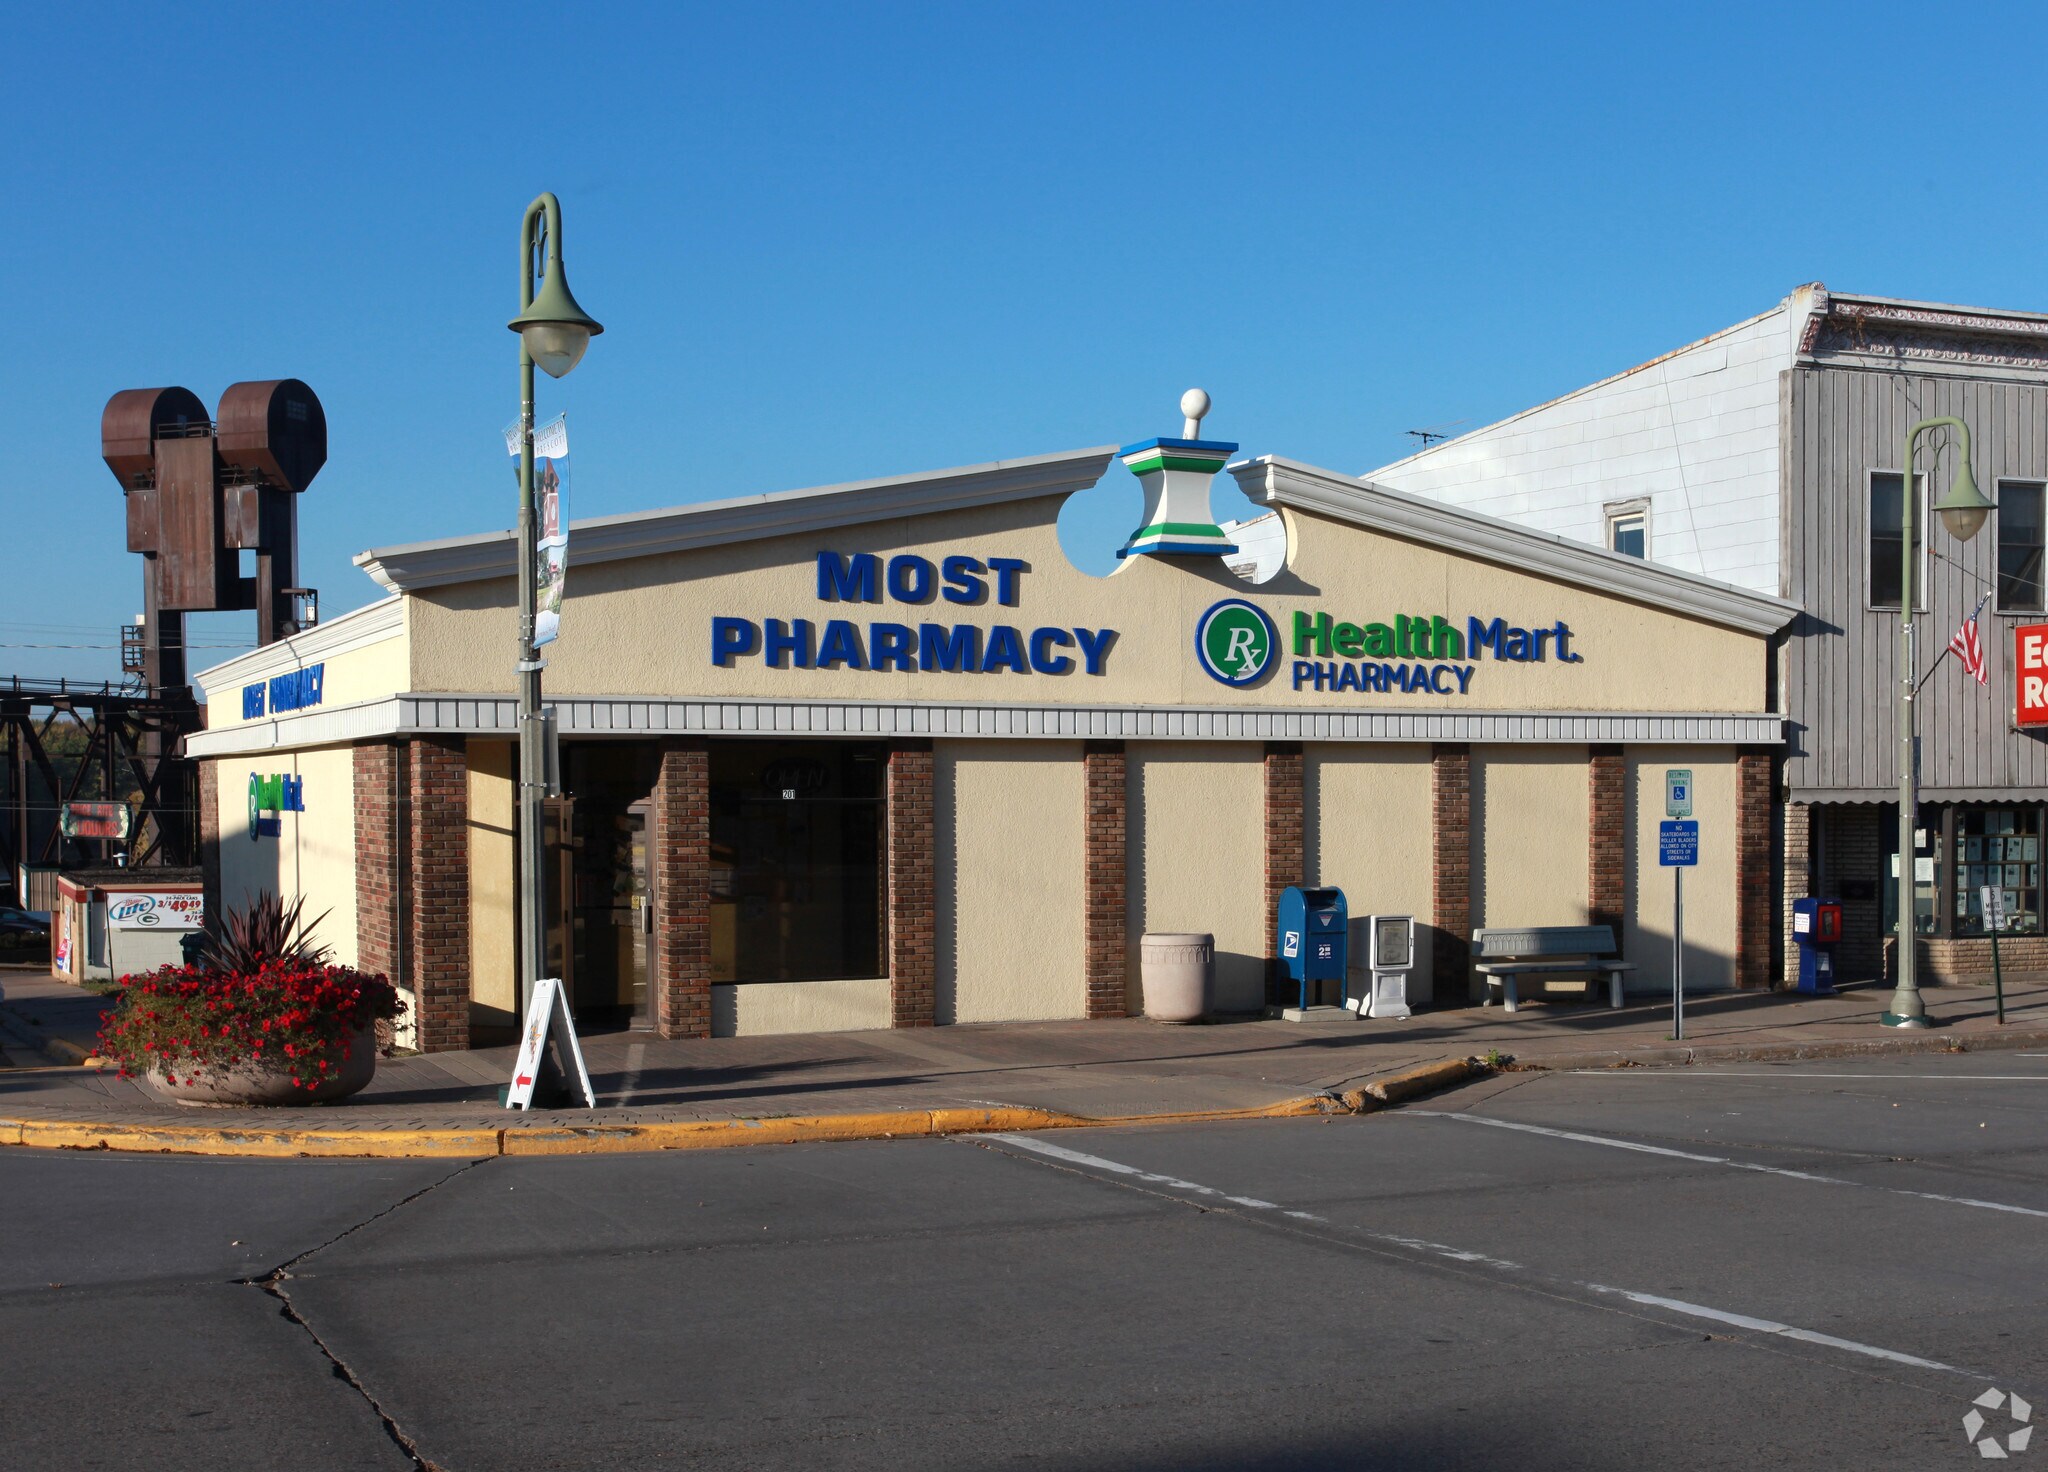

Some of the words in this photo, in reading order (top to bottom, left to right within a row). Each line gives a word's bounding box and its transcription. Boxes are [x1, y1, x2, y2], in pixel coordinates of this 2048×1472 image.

[536, 434, 566, 455] PRESCOTT
[817, 551, 1028, 605] MOST
[711, 616, 1115, 675] PHARMACY
[1224, 627, 1262, 672] Rx
[1292, 661, 1474, 695] PHARMACY
[783, 790, 795, 799] 201
[77, 820, 118, 837] LIQUORS
[117, 902, 150, 920] Lite
[1318, 946, 1325, 956] 2
